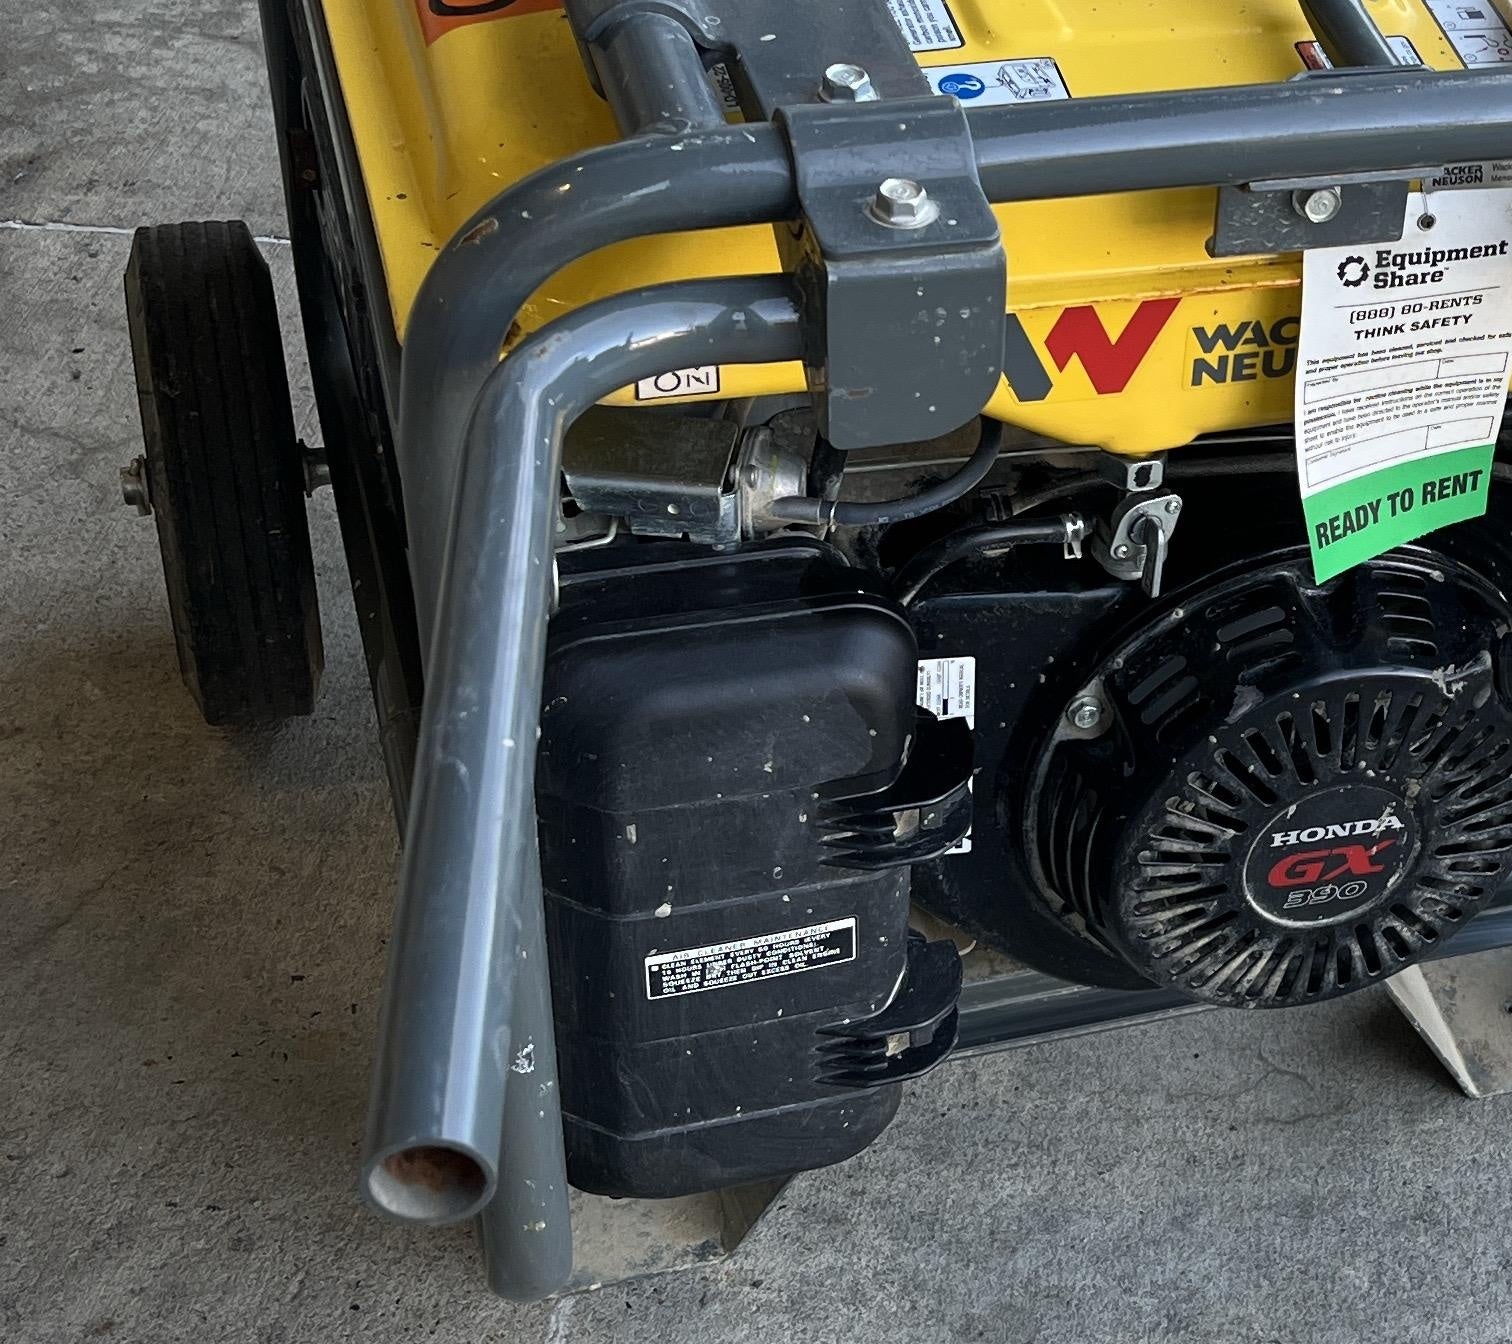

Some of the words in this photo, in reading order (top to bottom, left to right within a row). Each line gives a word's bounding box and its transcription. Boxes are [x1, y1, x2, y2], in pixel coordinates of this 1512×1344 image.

[1432, 173, 1483, 187] NEUSON
[1443, 164, 1483, 176] ACKER
[1374, 239, 1509, 269] Equipment
[1372, 269, 1444, 289] Share
[1349, 308, 1396, 325] (888)
[1400, 293, 1484, 316] 80-RENTS
[1192, 315, 1300, 354] WAC
[1353, 323, 1405, 341] THINK
[1409, 313, 1473, 332] SAFETY
[653, 370, 710, 393] ON
[1191, 349, 1298, 387] NEU
[1314, 497, 1383, 550] READY
[1386, 487, 1415, 518] TO
[1421, 468, 1484, 506] RENT
[1269, 815, 1406, 848] HONDA
[1267, 839, 1397, 888] GX
[1282, 880, 1368, 909] 390
[661, 960, 687, 970] CLEAN
[690, 954, 725, 965] ELEMENT
[729, 948, 754, 958] EVERY
[772, 939, 800, 949] HOURS
[673, 952, 690, 961] AIR
[697, 942, 746, 957] CLEANER
[753, 924, 829, 946] MAINTENANCE
[661, 972, 687, 982] WASH
[788, 945, 825, 959] SOLVENT
[662, 976, 701, 987] SQUEEZE
[781, 955, 808, 965] CLEAN
[675, 963, 702, 973] HOURS
[736, 952, 762, 962] DUSTY
[662, 986, 676, 994] OIL
[681, 982, 700, 991] AND
[702, 975, 738, 987] SQUEEZE
[742, 971, 758, 980] OUT
[761, 965, 790, 976] EXCESS
